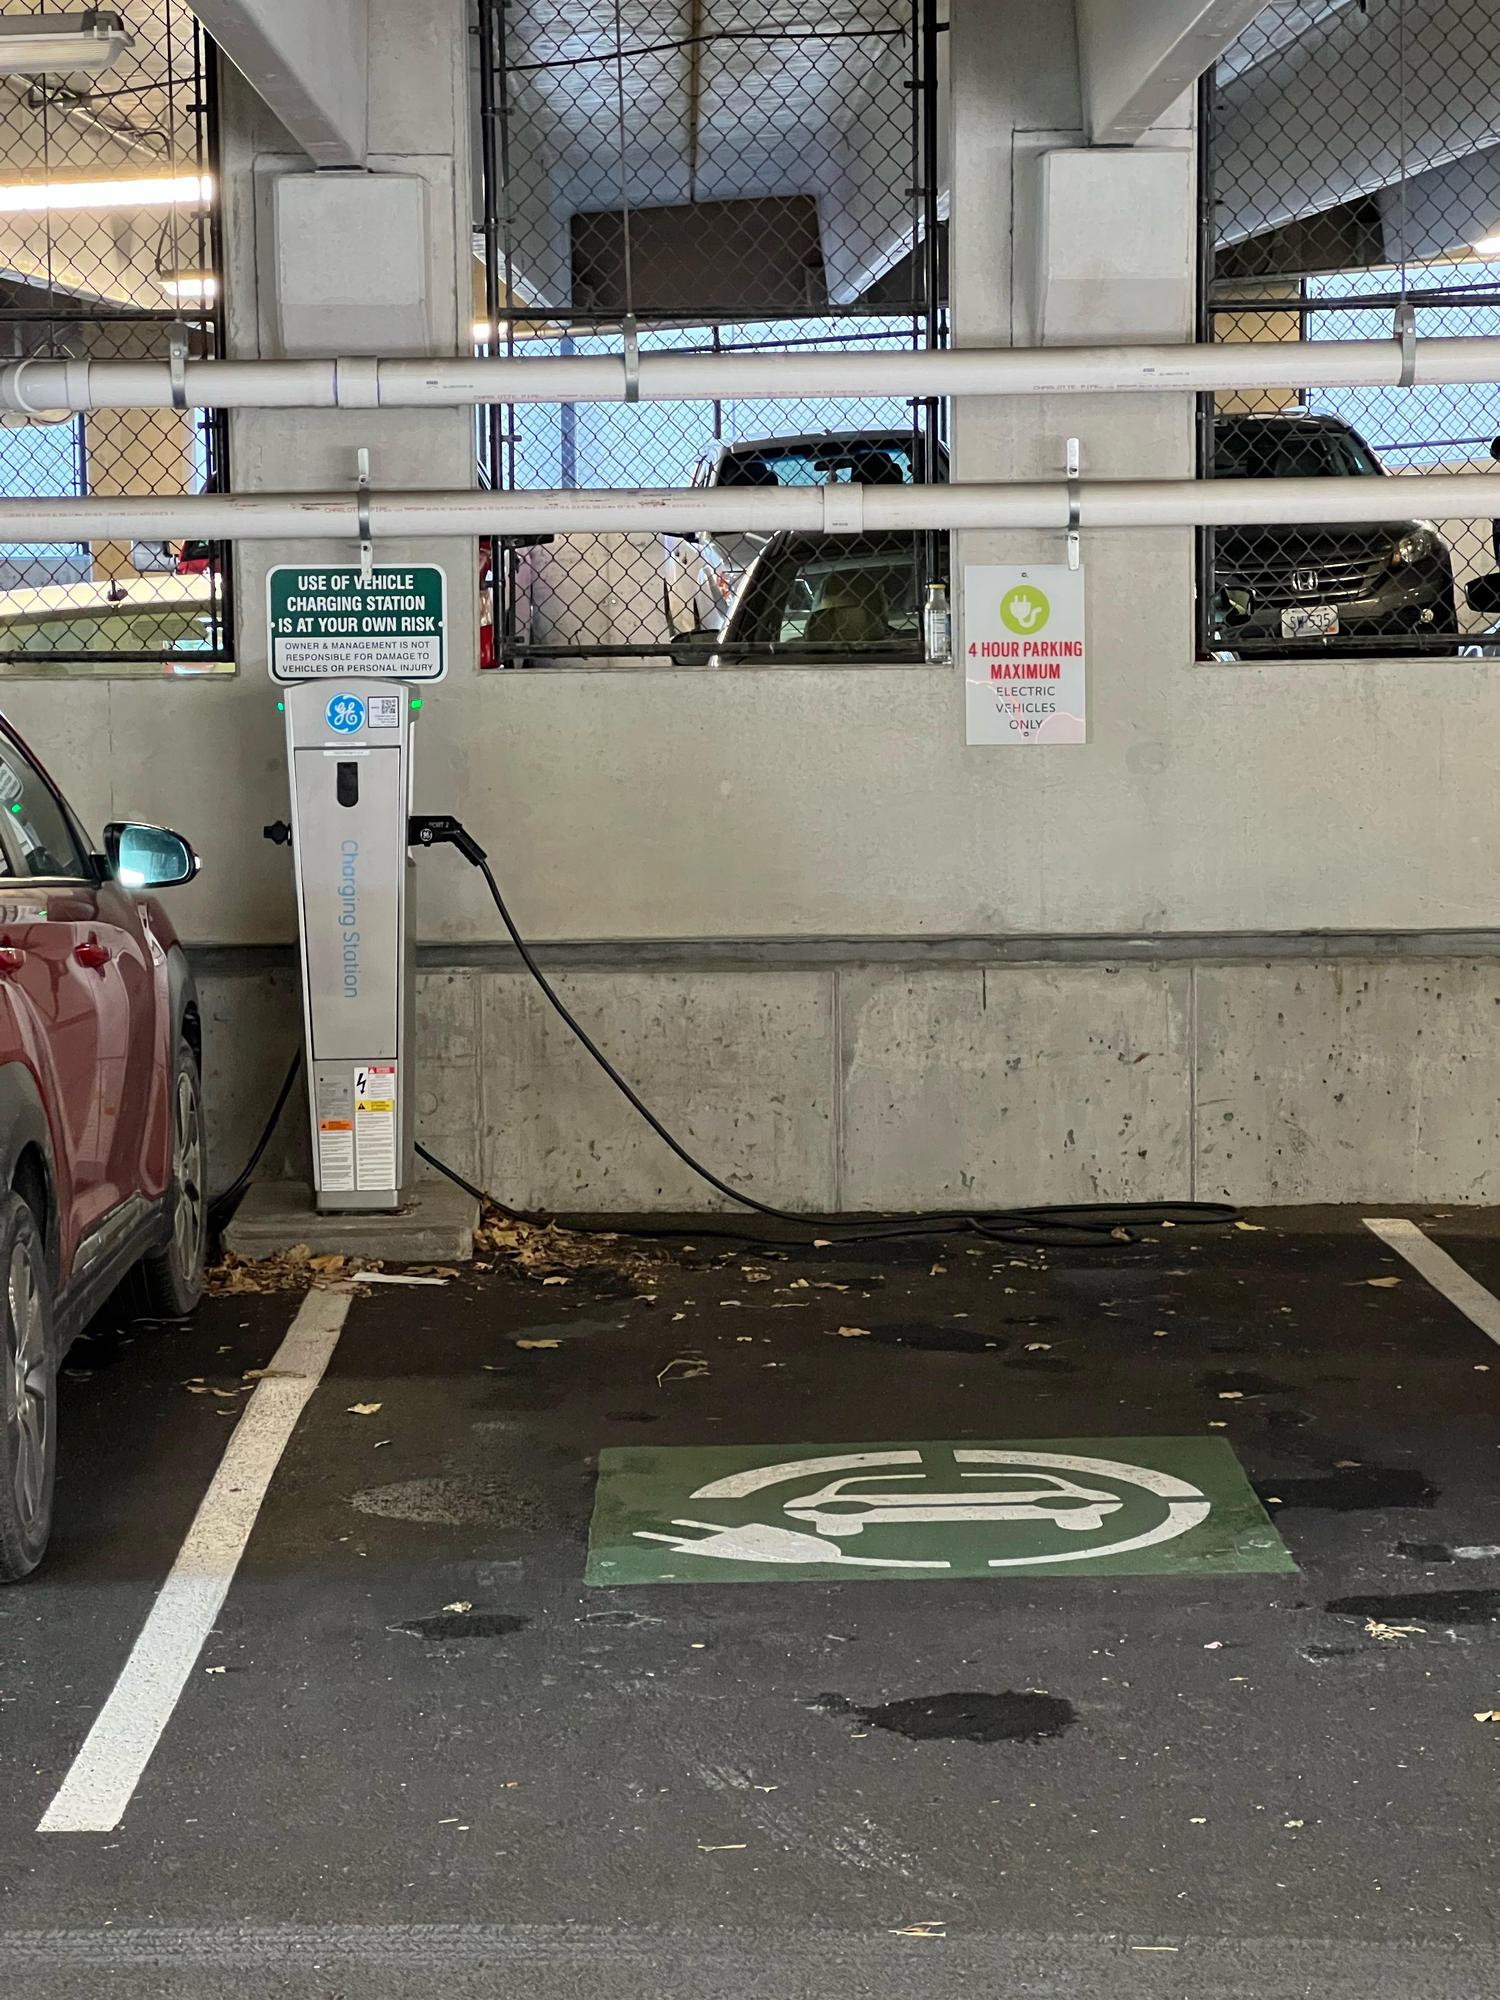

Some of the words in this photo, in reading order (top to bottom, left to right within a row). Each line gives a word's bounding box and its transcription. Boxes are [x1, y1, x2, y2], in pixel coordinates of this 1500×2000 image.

[298, 576, 326, 591] USE
[331, 575, 350, 590] OF
[354, 575, 413, 590] VEHICLE
[287, 596, 361, 611] CHARGING
[367, 596, 425, 611] STATION
[278, 617, 291, 633] IS
[297, 617, 314, 632] AT
[318, 617, 358, 632] YOUR
[362, 617, 396, 632] OWN
[401, 616, 435, 631] RISK
[285, 642, 319, 650] OWNER
[331, 641, 396, 649] MANAGEMENT
[399, 641, 408, 649] IS
[411, 641, 430, 649] NOT
[968, 642, 978, 657] 4
[982, 642, 1019, 657] HOUR
[1023, 641, 1083, 657] PARKING
[286, 653, 350, 661] RESPONSIBLE
[354, 653, 373, 661] FOR
[417, 652, 430, 660] TO
[282, 665, 328, 673] VEHICLES
[347, 664, 397, 672] PERSONAL
[991, 664, 1061, 679] MAXIMUM
[996, 686, 1056, 696] ELECTRIC
[995, 703, 1056, 713] VEHICLES
[1009, 719, 1043, 730] ONLY
[337, 839, 360, 926] Charging
[343, 932, 361, 998] Station
